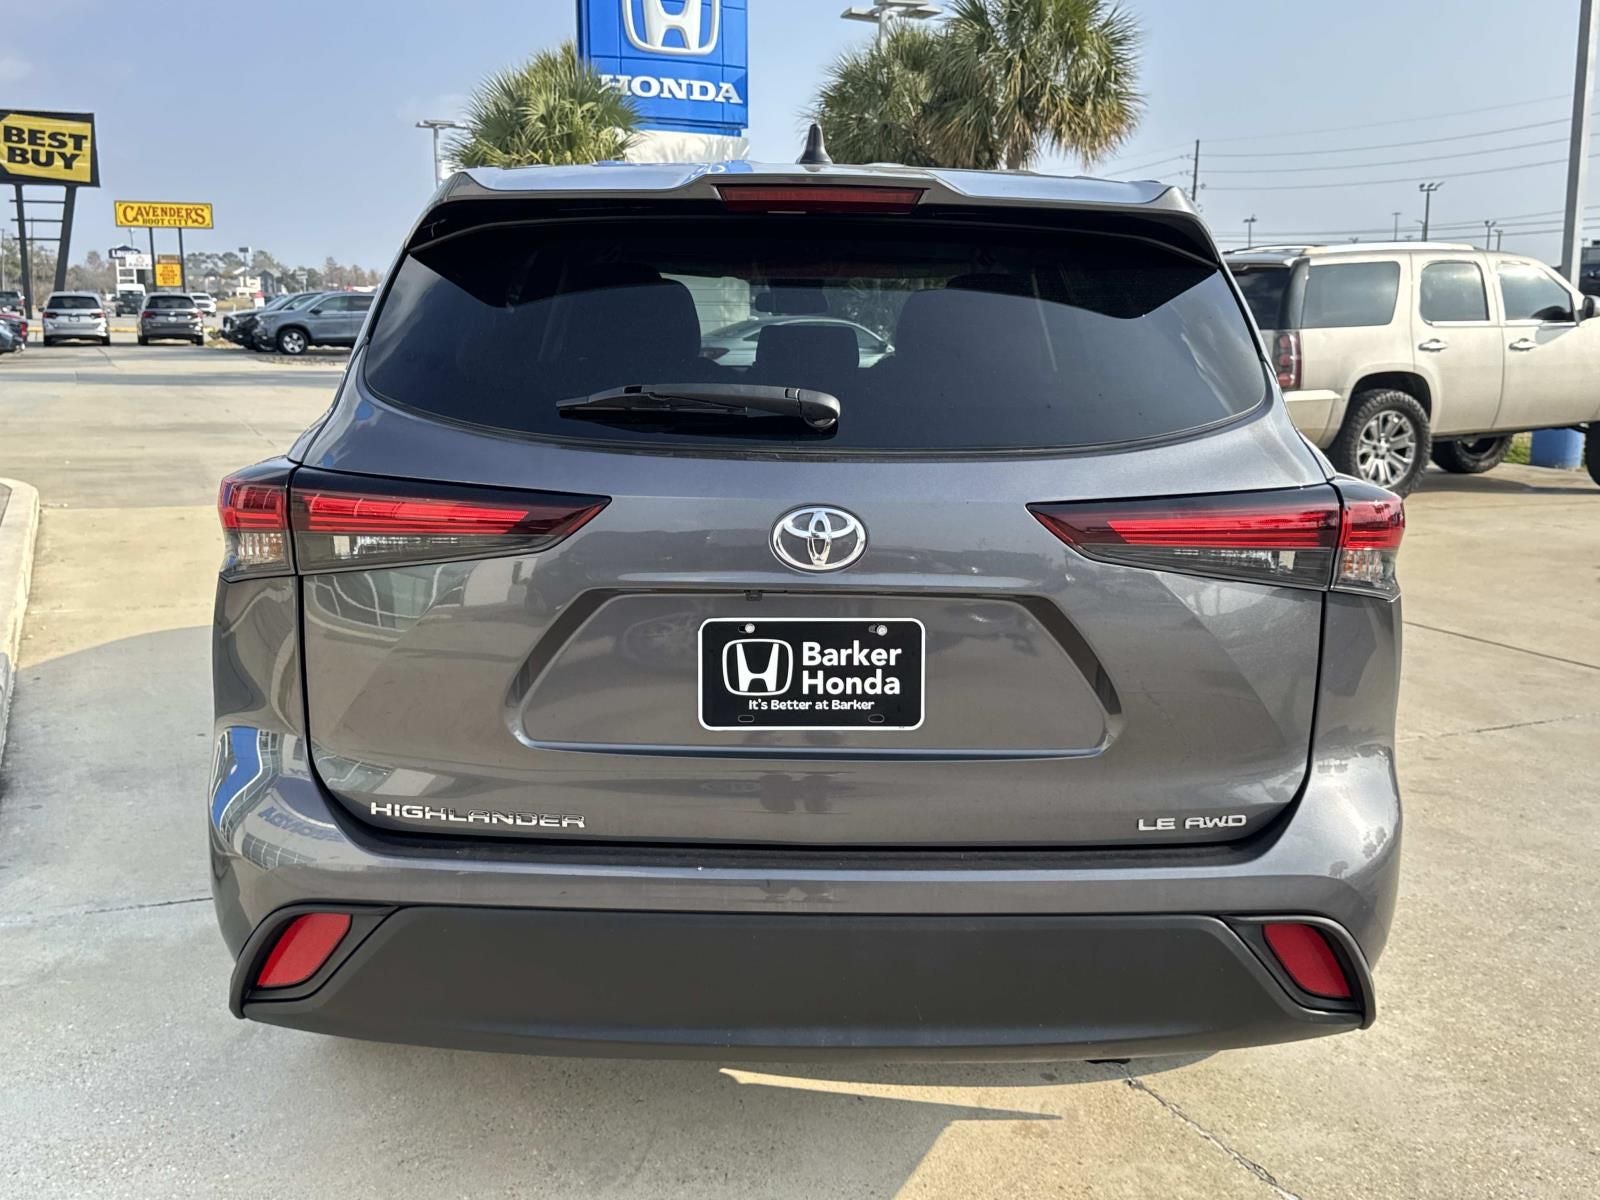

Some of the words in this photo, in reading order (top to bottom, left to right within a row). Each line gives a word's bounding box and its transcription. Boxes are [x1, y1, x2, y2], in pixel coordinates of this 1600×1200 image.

[598, 74, 743, 104] HONDA
[4, 125, 88, 151] BEST
[8, 145, 81, 170] BUY
[123, 205, 206, 225] CAVENDER'S
[167, 218, 189, 226] CITY
[802, 640, 902, 667] Barker
[802, 669, 901, 695] Honda
[748, 698, 768, 711] It's
[770, 699, 812, 711] Better
[814, 700, 829, 710] at
[831, 699, 875, 711] Barker
[370, 801, 585, 828] HIGHLANDER
[1137, 817, 1175, 831] LE
[1185, 814, 1247, 830] AWD
